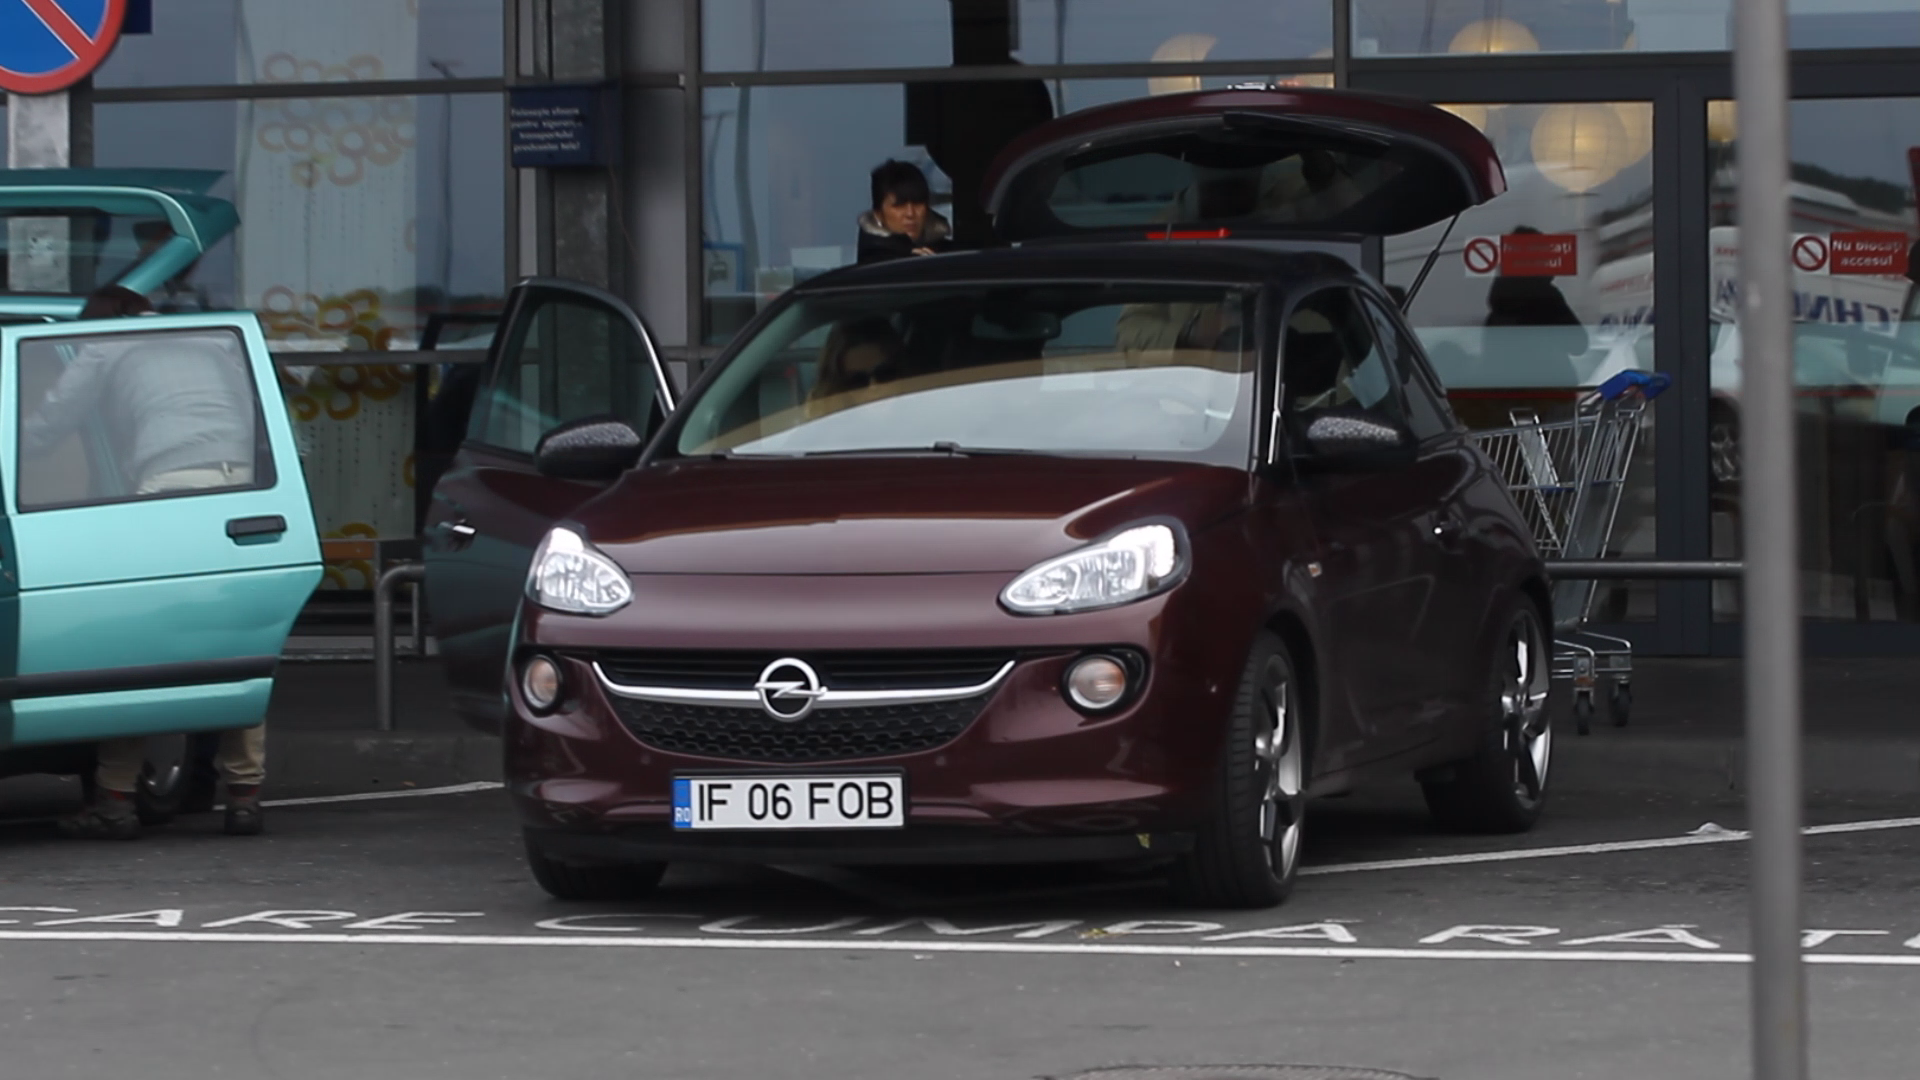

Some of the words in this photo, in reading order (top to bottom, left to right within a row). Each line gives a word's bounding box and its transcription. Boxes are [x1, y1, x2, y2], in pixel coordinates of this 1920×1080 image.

[1832, 240, 1852, 251] Nu
[1840, 255, 1893, 266] accesul
[698, 783, 732, 821] IF
[749, 783, 792, 820] 06
[808, 781, 893, 820] FOB
[674, 807, 691, 822] RO
